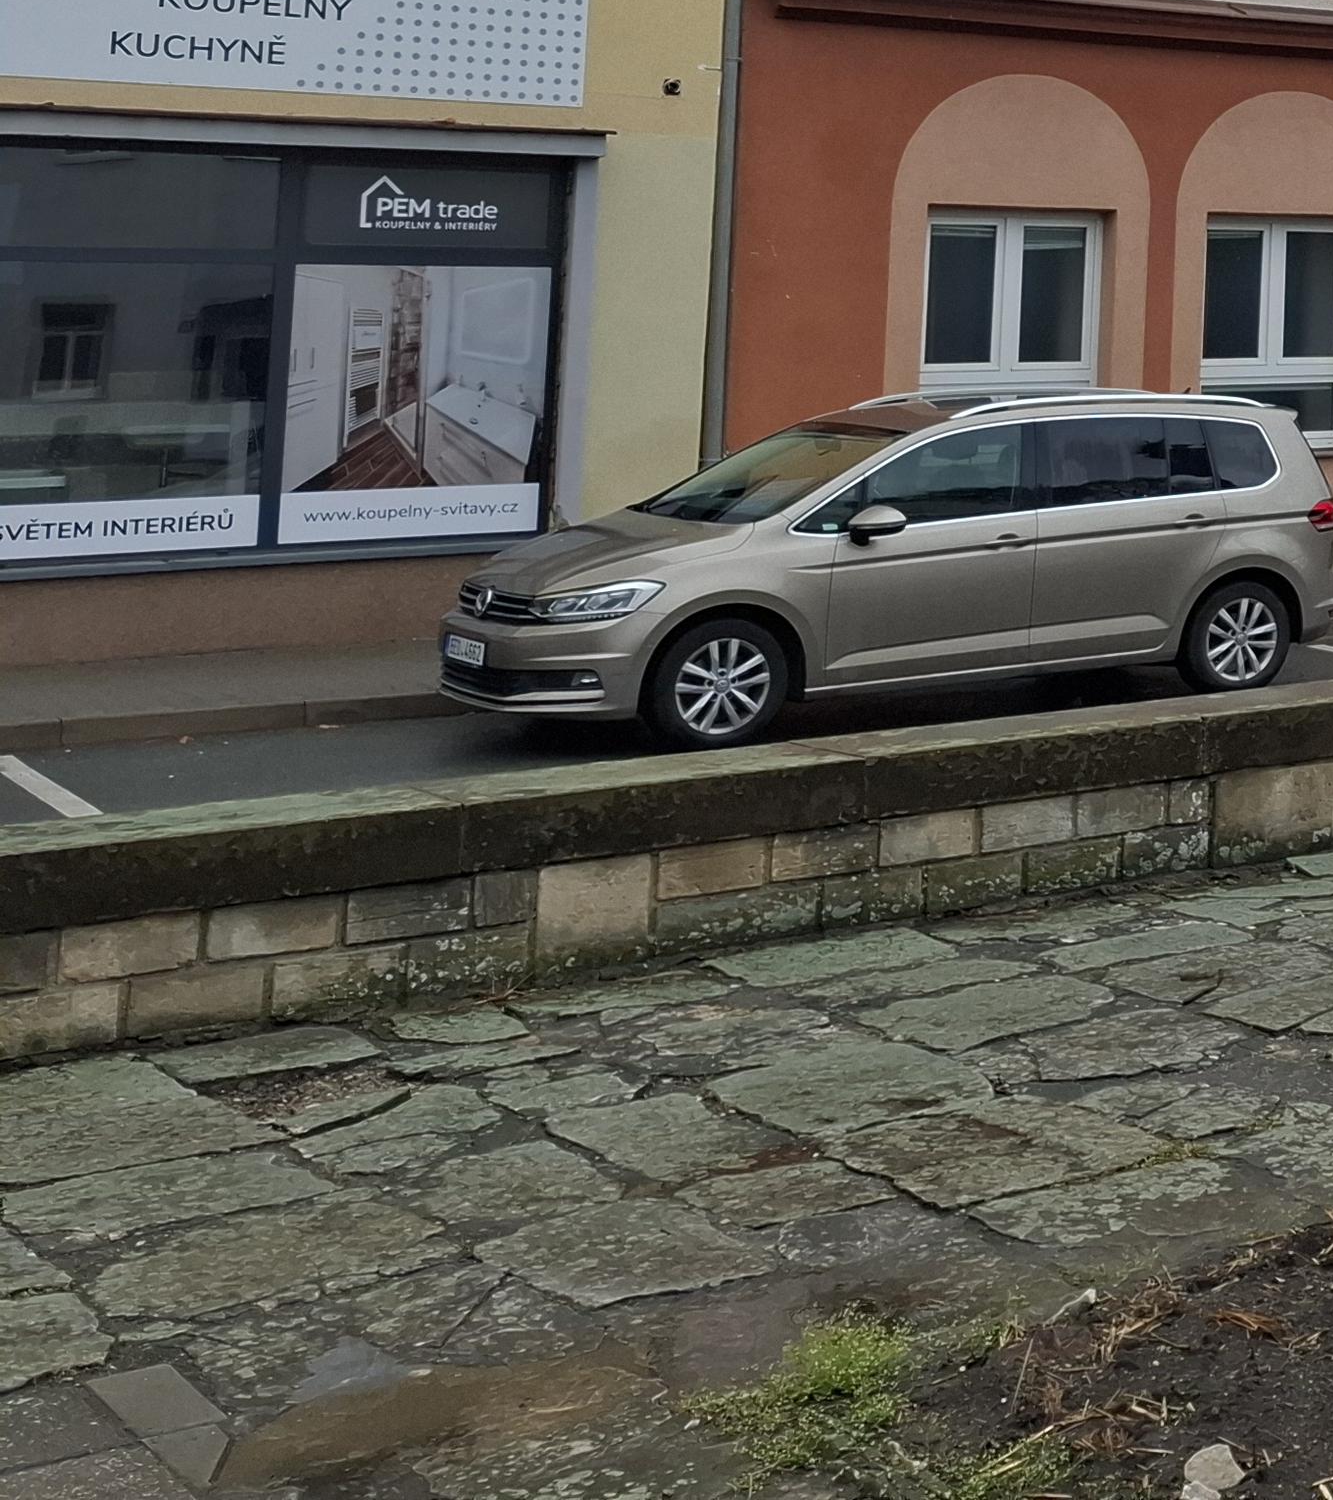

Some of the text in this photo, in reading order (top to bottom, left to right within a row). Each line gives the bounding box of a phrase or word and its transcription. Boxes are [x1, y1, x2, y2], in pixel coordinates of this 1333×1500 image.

[110, 31, 287, 65] KUCHYNĚ
[376, 197, 498, 219] PEM trade
[375, 220, 497, 231] KOUPELNY & INTERIÉRY
[103, 508, 234, 537] INTERIÉRŮ
[304, 501, 519, 523] www.koupelny-svitavy.cz
